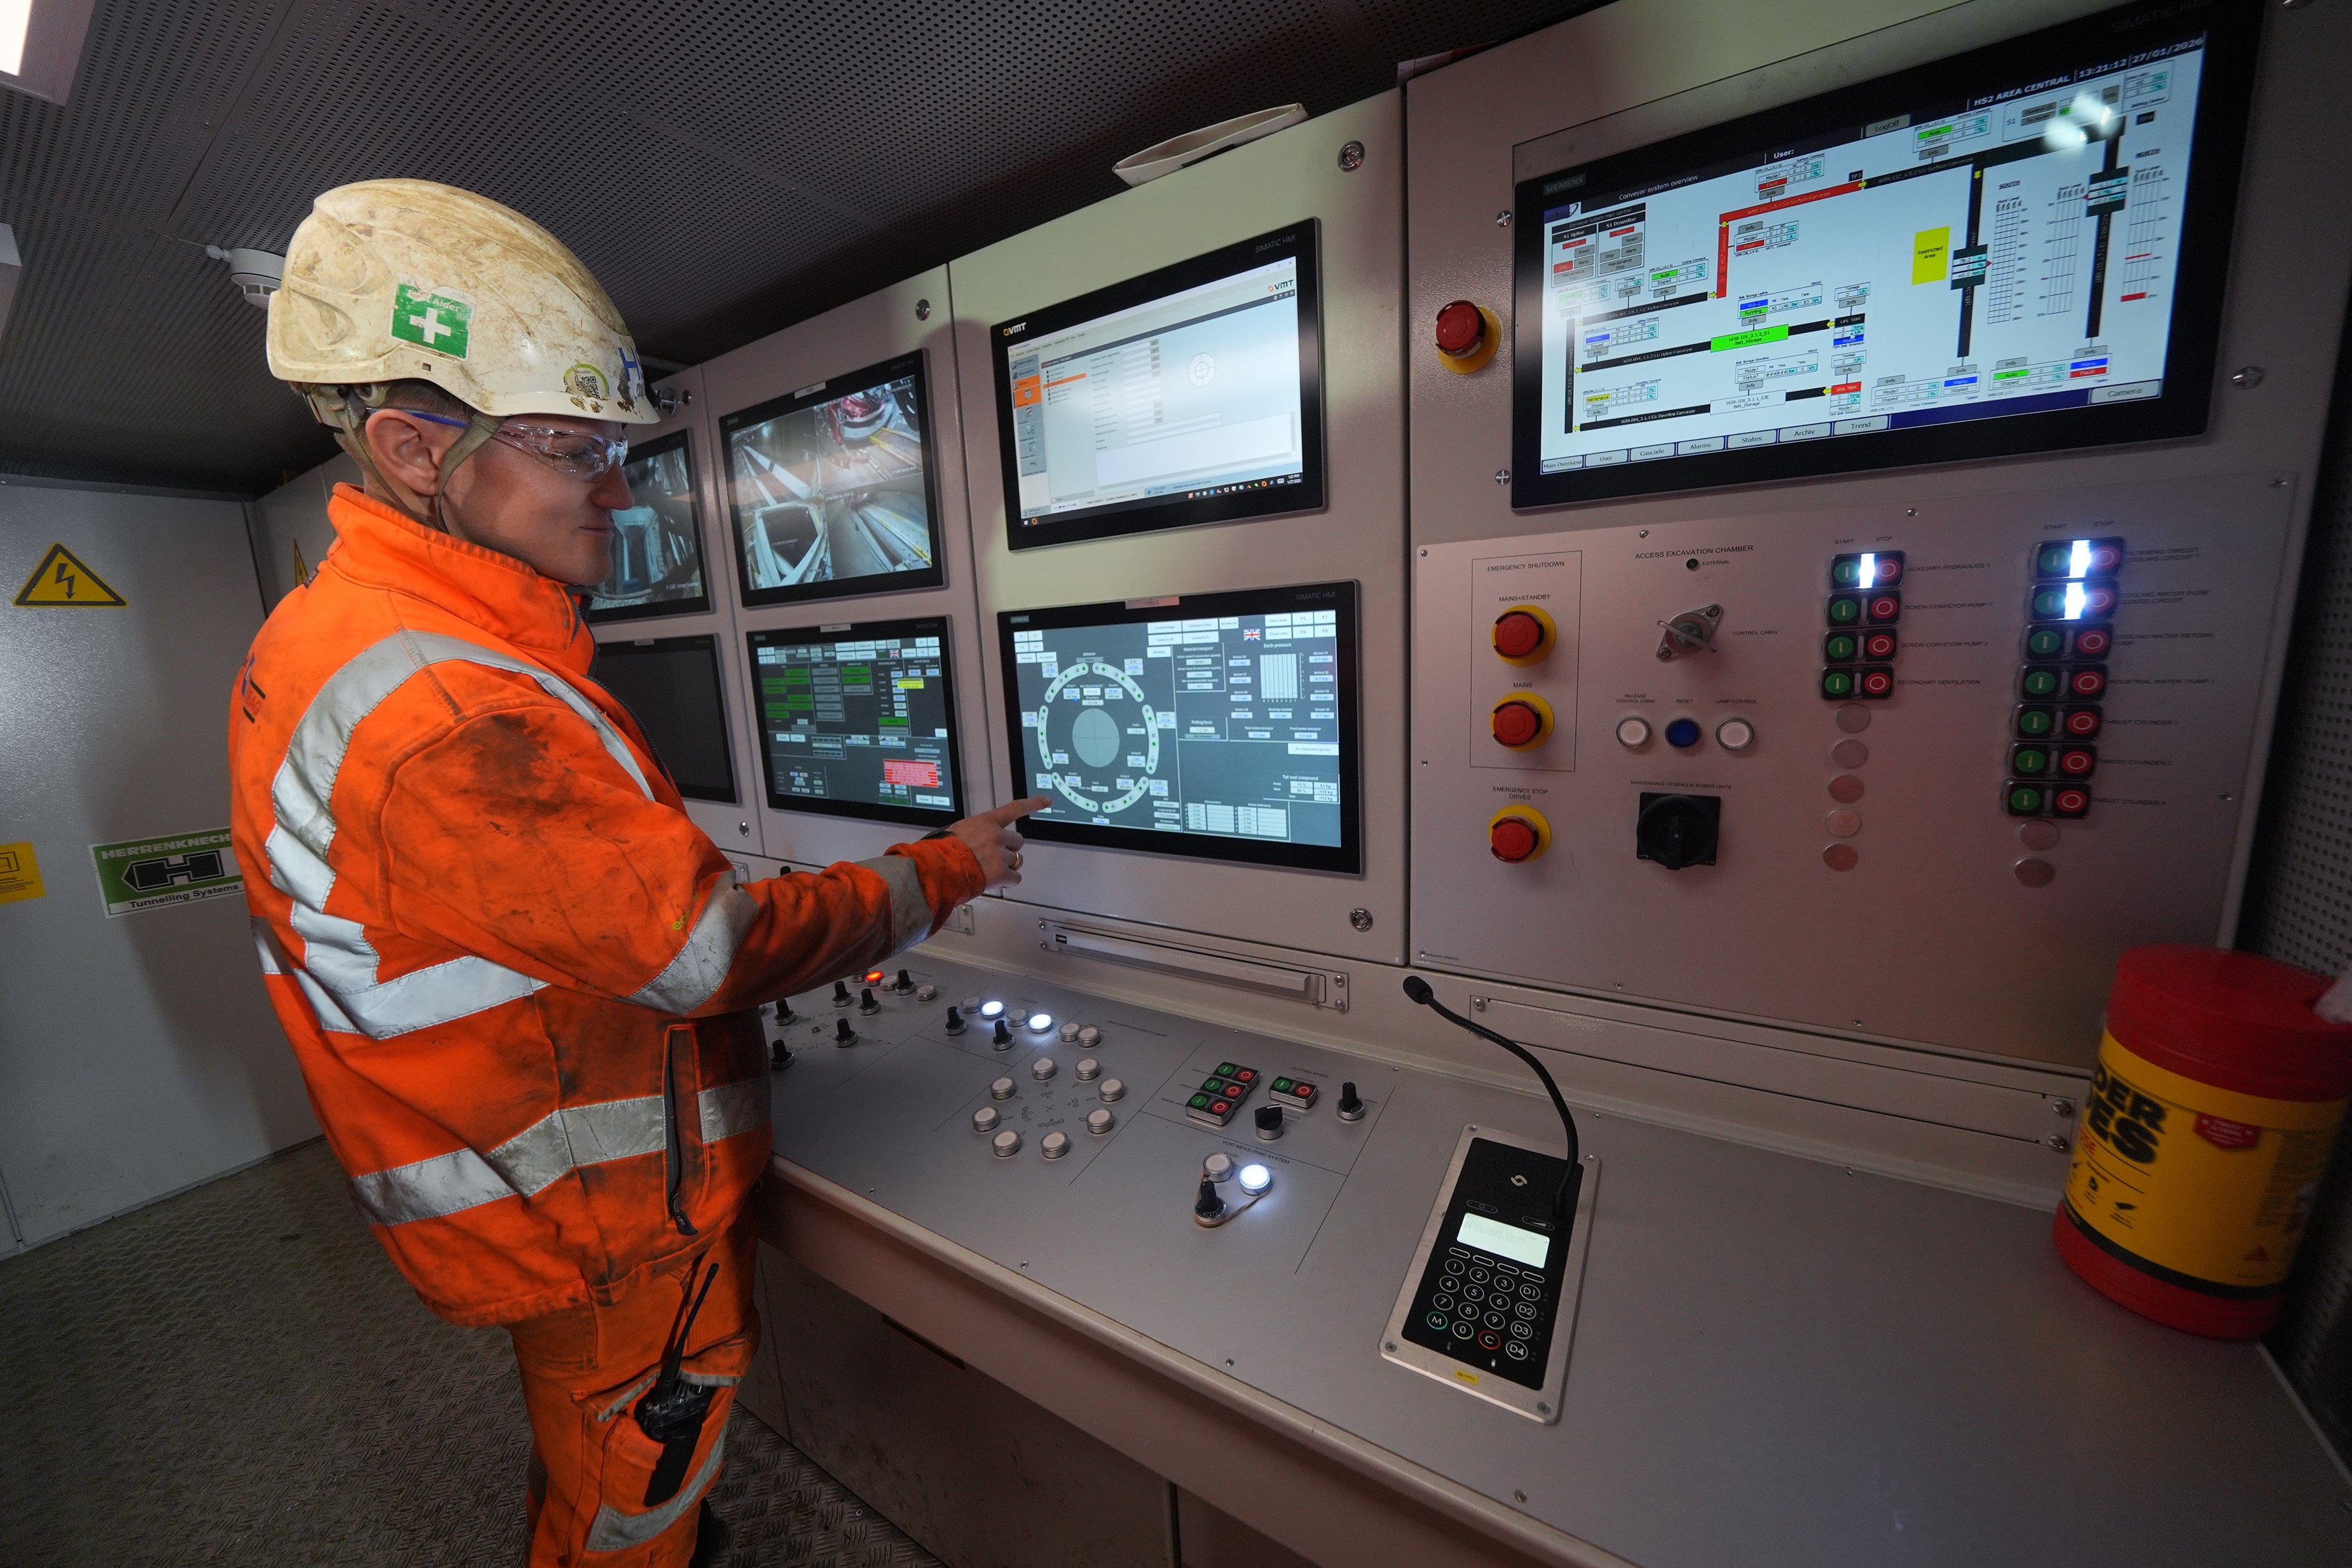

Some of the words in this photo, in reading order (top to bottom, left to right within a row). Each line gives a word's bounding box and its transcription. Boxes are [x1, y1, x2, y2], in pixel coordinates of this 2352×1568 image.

[2079, 58, 2127, 78] 13:21:12
[2131, 37, 2203, 63] 27/01/2026
[1974, 97, 1993, 106] HS2
[1995, 88, 2022, 100] AREA
[2024, 75, 2071, 93] CENTRAL
[1875, 119, 1899, 132] LogOff
[1774, 149, 1795, 159] User:
[1545, 177, 1583, 192] SIEMENS
[1619, 189, 1646, 200] Conveyor
[1648, 182, 1669, 194] system
[1671, 175, 1699, 187] overview
[1569, 219, 1588, 228] Conveyor
[1617, 208, 1632, 217] control
[1614, 217, 1636, 226] Downline
[1571, 230, 1585, 238] Upline
[1255, 238, 1282, 254] SIMATIC
[1282, 234, 1296, 245] HMI
[1917, 245, 1943, 256] Restricted
[1608, 257, 1632, 268] Maintenance
[1735, 337, 1762, 346] Belt_Storage
[2084, 348, 2096, 356] Info
[2107, 385, 2142, 398] Camera
[1733, 401, 1760, 409] Belt_Storage
[1851, 421, 1871, 430] Trend
[1794, 428, 1815, 437] Archiv
[1742, 435, 1762, 443] States
[1690, 442, 1711, 450] Alarms
[1640, 447, 1665, 457] Cascade
[1543, 461, 1556, 470] Main
[1634, 551, 1665, 560] ACCESS
[1665, 548, 1714, 558] EXCAVATION
[1715, 545, 1754, 555] CHAMBER
[1487, 563, 1526, 572] EMERGENCY
[1528, 561, 1565, 570] SHUTDOWN
[1296, 592, 1322, 601] SIMATIC
[1498, 593, 1551, 603] MAINS+STANDBY
[1492, 786, 1530, 794] EMERGENCY
[101, 835, 231, 859] HERRENKNECH
[128, 892, 190, 909] Tunnelling
[193, 883, 239, 897] Systems
[1291, 1066, 1311, 1075] CUTTING
[1222, 1140, 1235, 1148] VOID
[1234, 1143, 1267, 1157] MEASURING
[1267, 1154, 1290, 1164] SYSTEM
[1476, 1271, 1482, 1279] 2
[1446, 1279, 1453, 1288] 4
[1501, 1279, 1507, 1288] 3
[1471, 1288, 1477, 1297] 5
[1523, 1286, 1537, 1297] D1
[1440, 1297, 1447, 1306] 7
[1496, 1297, 1503, 1306] 6
[1465, 1306, 1472, 1315] 8
[1518, 1305, 1534, 1316] D2
[1432, 1316, 1443, 1326] M
[1491, 1316, 1498, 1325] 9
[1514, 1325, 1529, 1335] D3
[1486, 1335, 1494, 1345] C
[1508, 1345, 1525, 1356] D4
